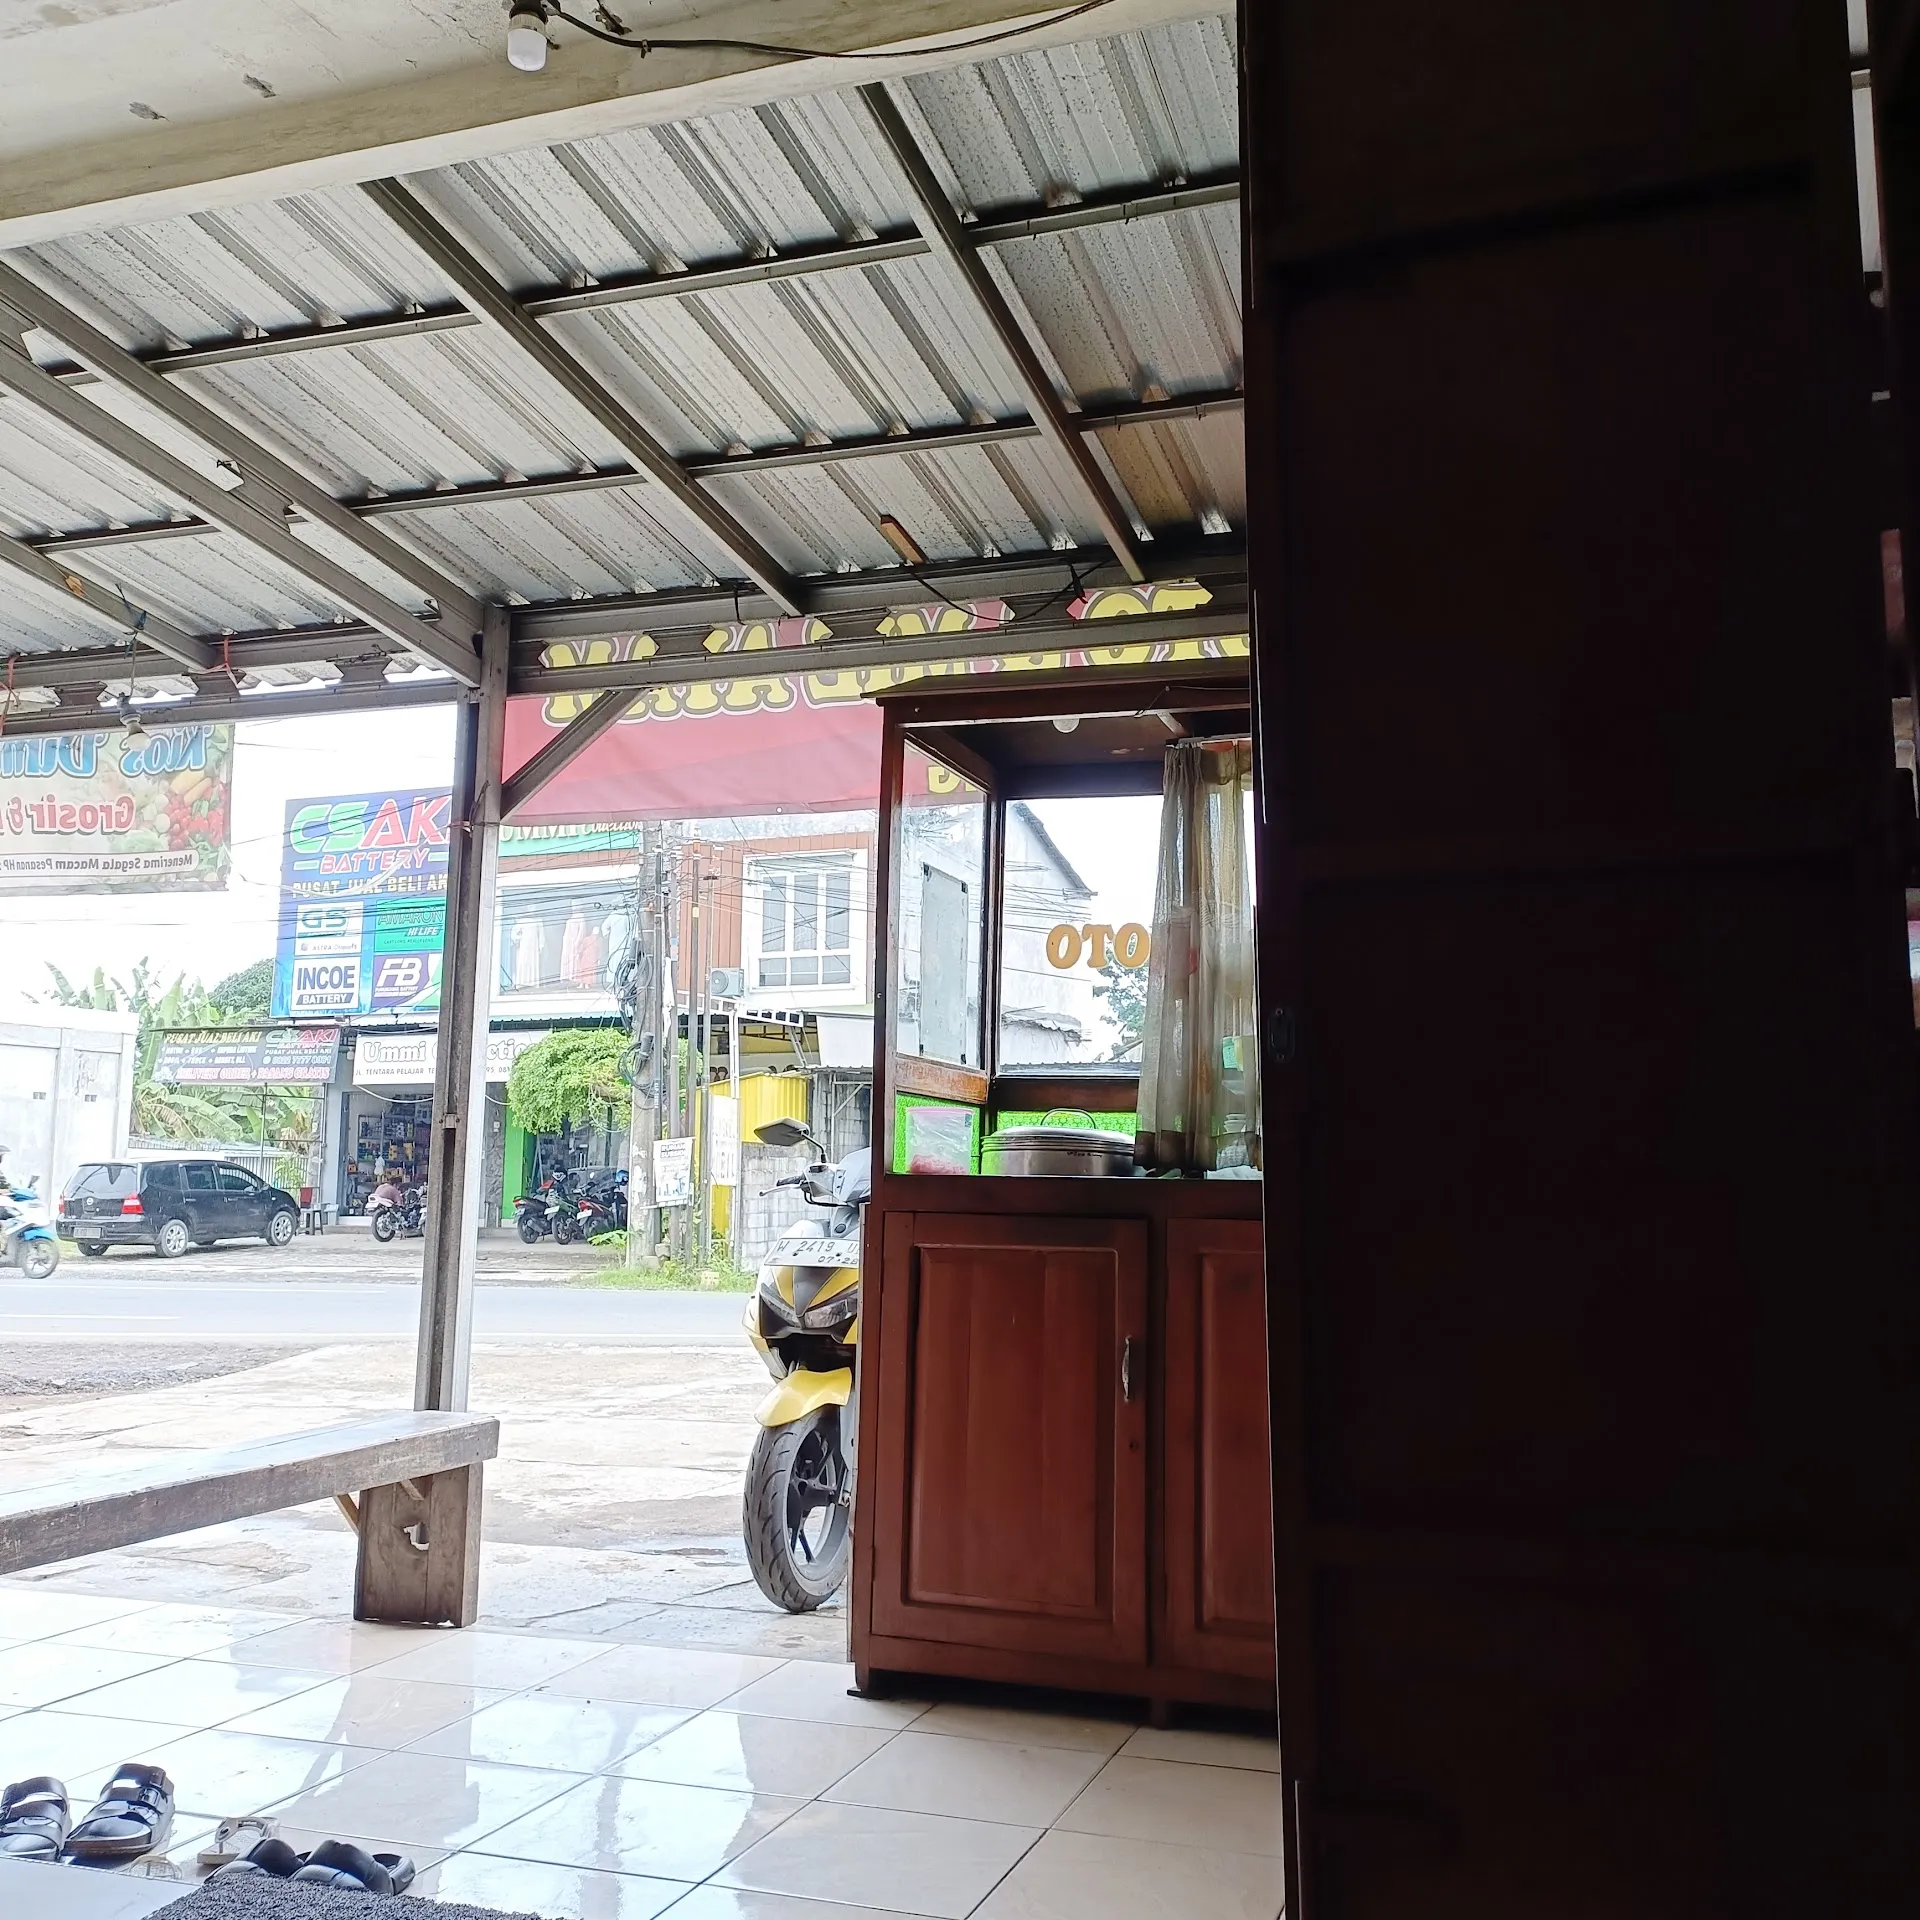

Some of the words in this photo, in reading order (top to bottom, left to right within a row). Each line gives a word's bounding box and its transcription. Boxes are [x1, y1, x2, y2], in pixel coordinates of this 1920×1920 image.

[290, 795, 453, 853] CSAK
[319, 848, 431, 875] BATTERY
[296, 965, 356, 991] INCOE
[302, 993, 349, 1005] BATTERY
[363, 1040, 427, 1063] Ummi
